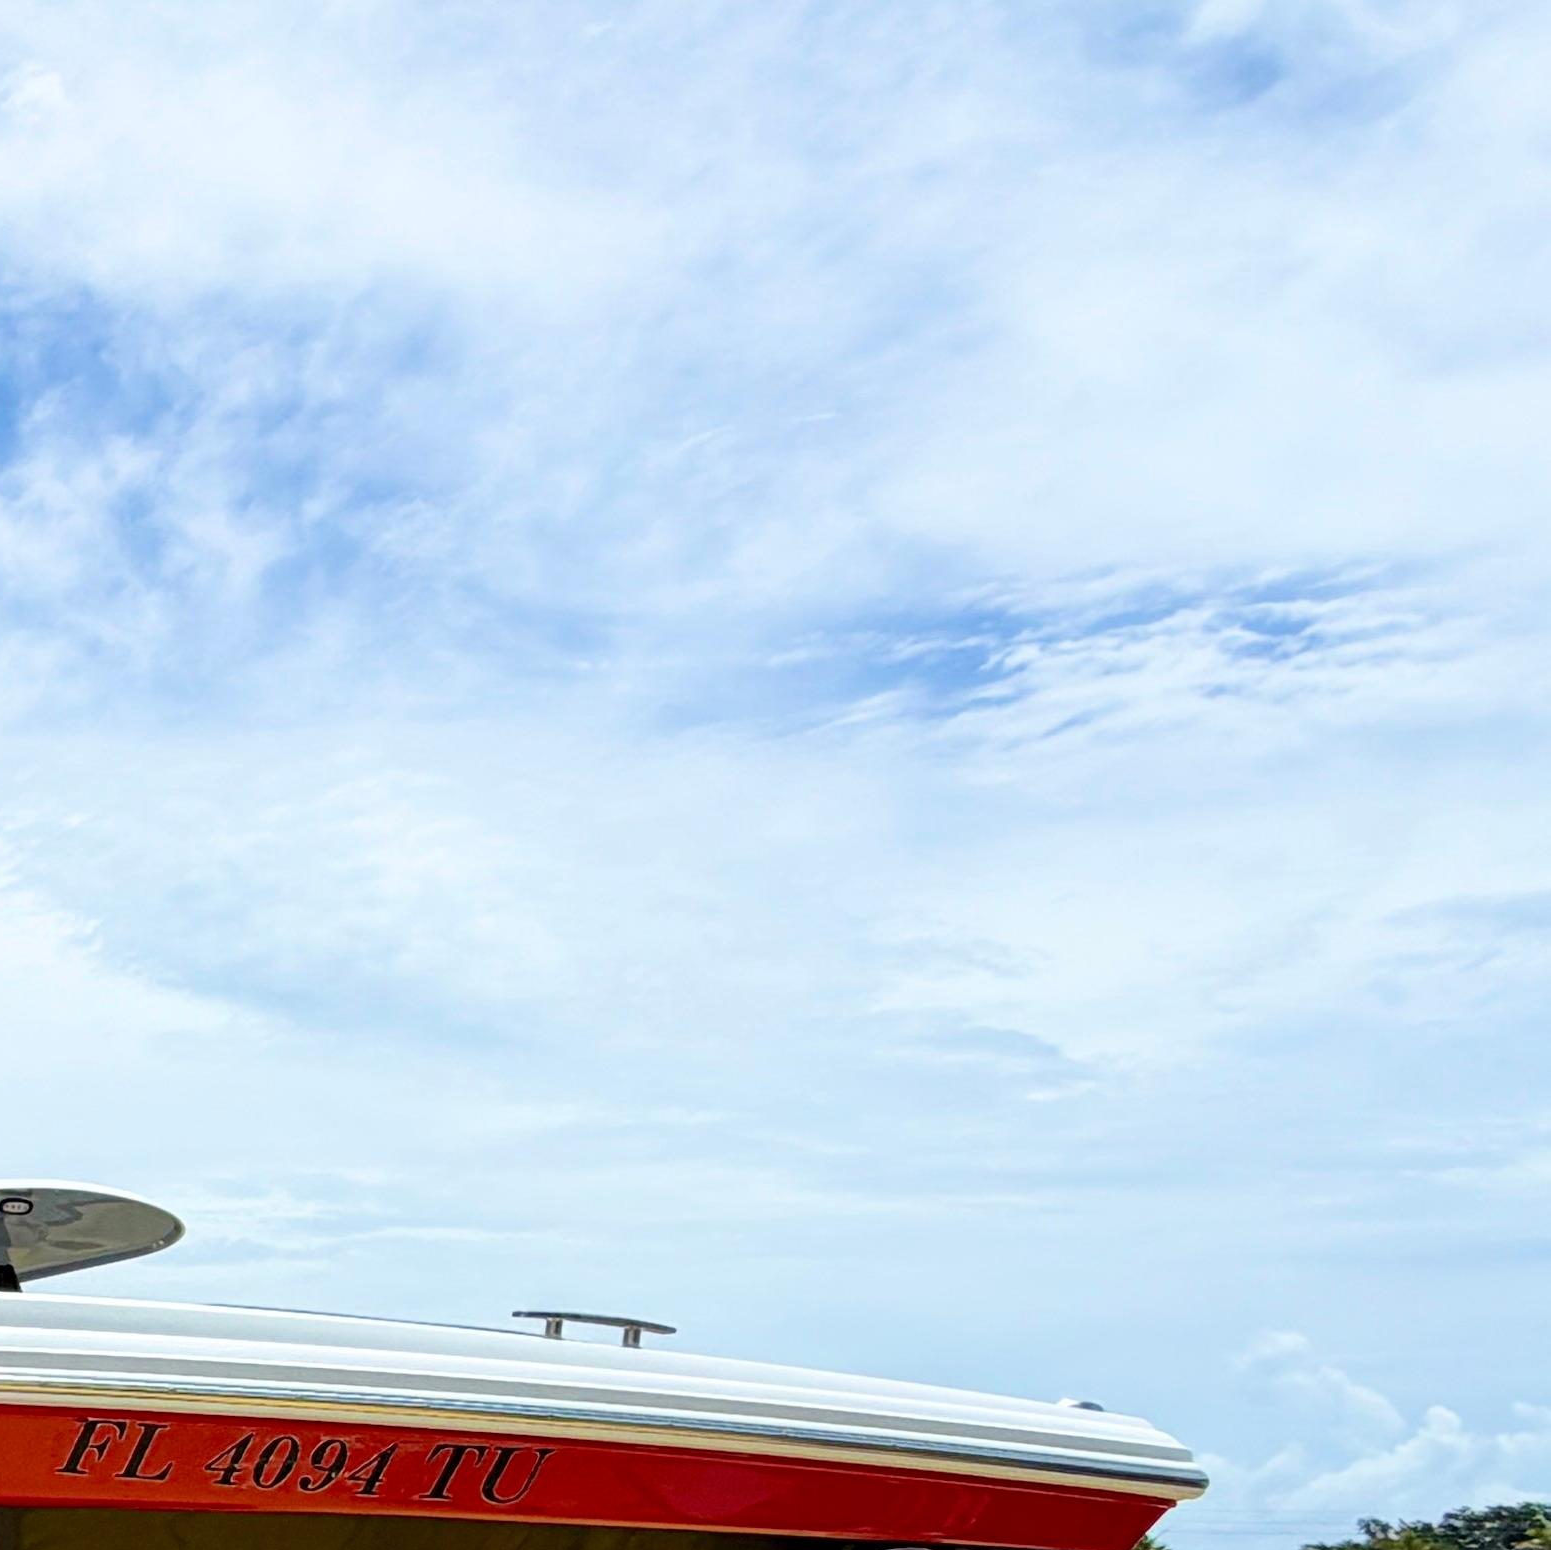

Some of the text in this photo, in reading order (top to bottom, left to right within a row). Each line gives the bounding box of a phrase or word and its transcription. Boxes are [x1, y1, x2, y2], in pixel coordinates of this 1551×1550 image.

[55, 1417, 556, 1504] FL 4094 TU
